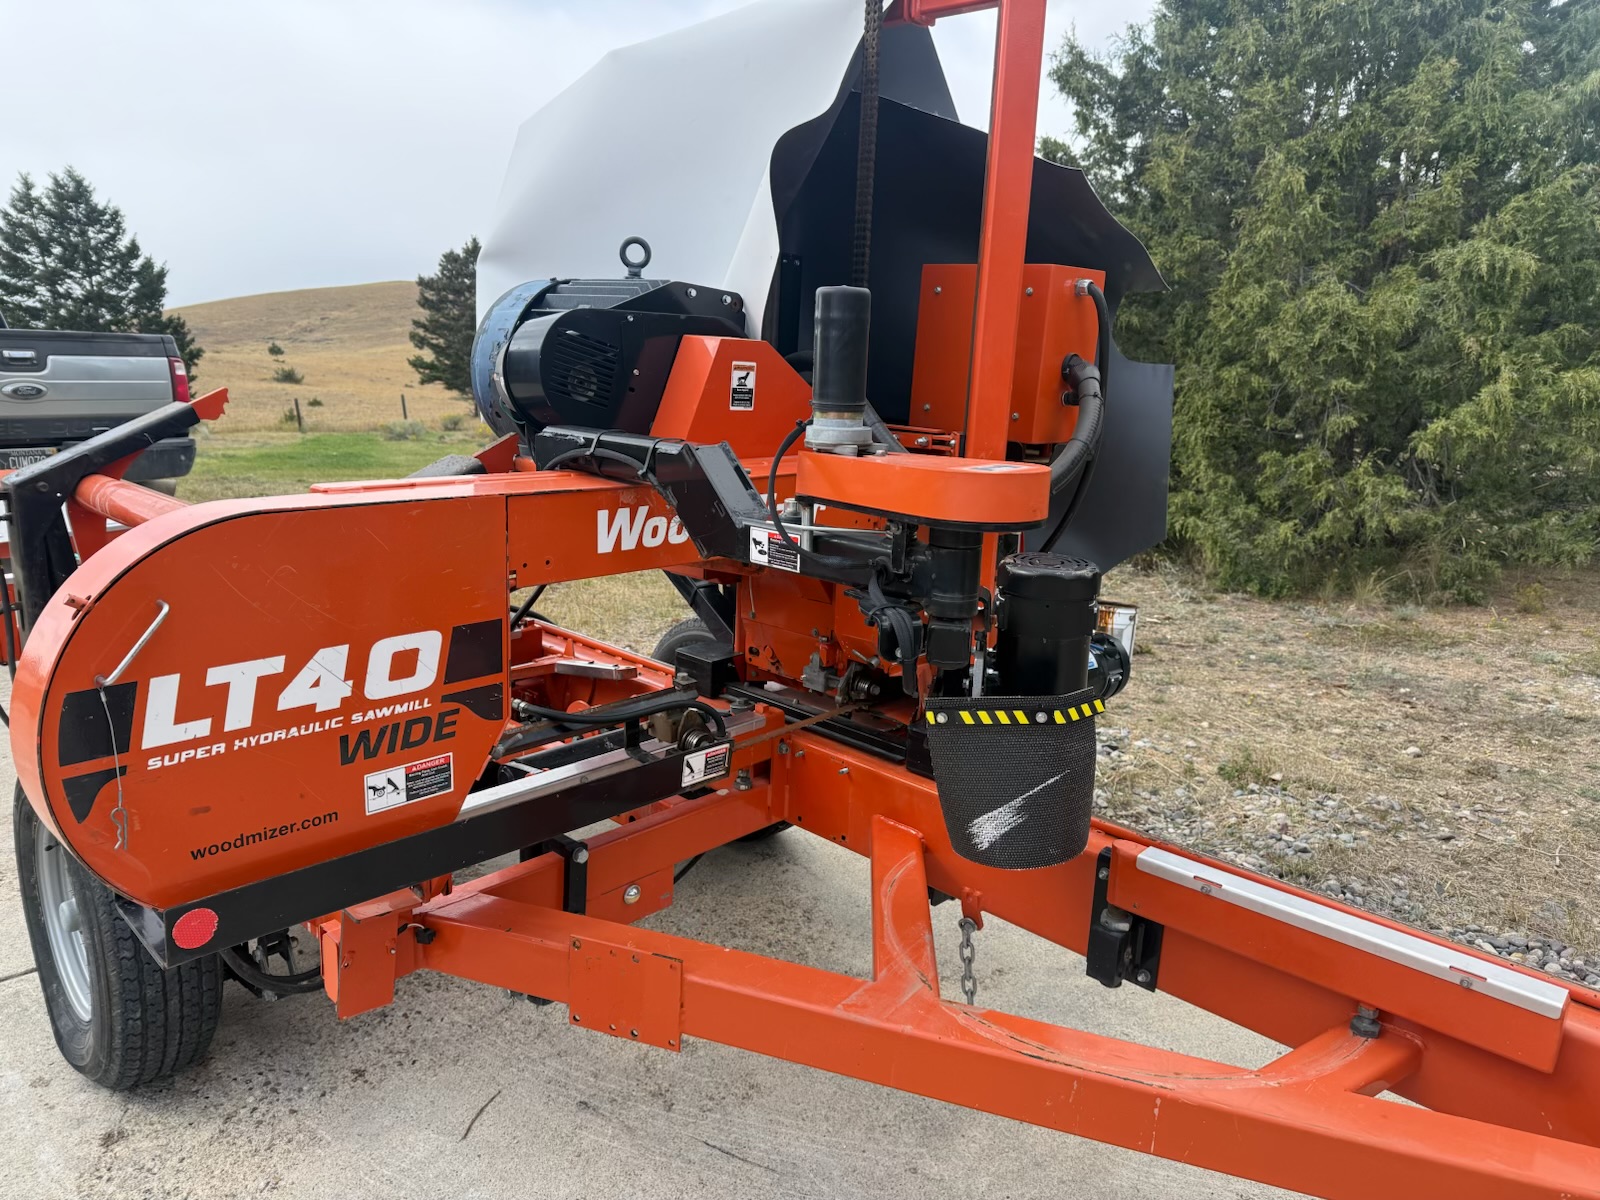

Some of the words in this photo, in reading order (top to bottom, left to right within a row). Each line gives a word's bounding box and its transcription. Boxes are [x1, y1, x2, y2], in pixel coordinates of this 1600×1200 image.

[141, 630, 443, 750] LT40
[147, 743, 226, 770] SUPER
[234, 716, 344, 750] HYDRAULIC
[351, 698, 432, 724] SAWMILL
[339, 708, 461, 766] WIDE
[416, 758, 446, 771] DANGER
[190, 811, 339, 861] woodmizer.com
